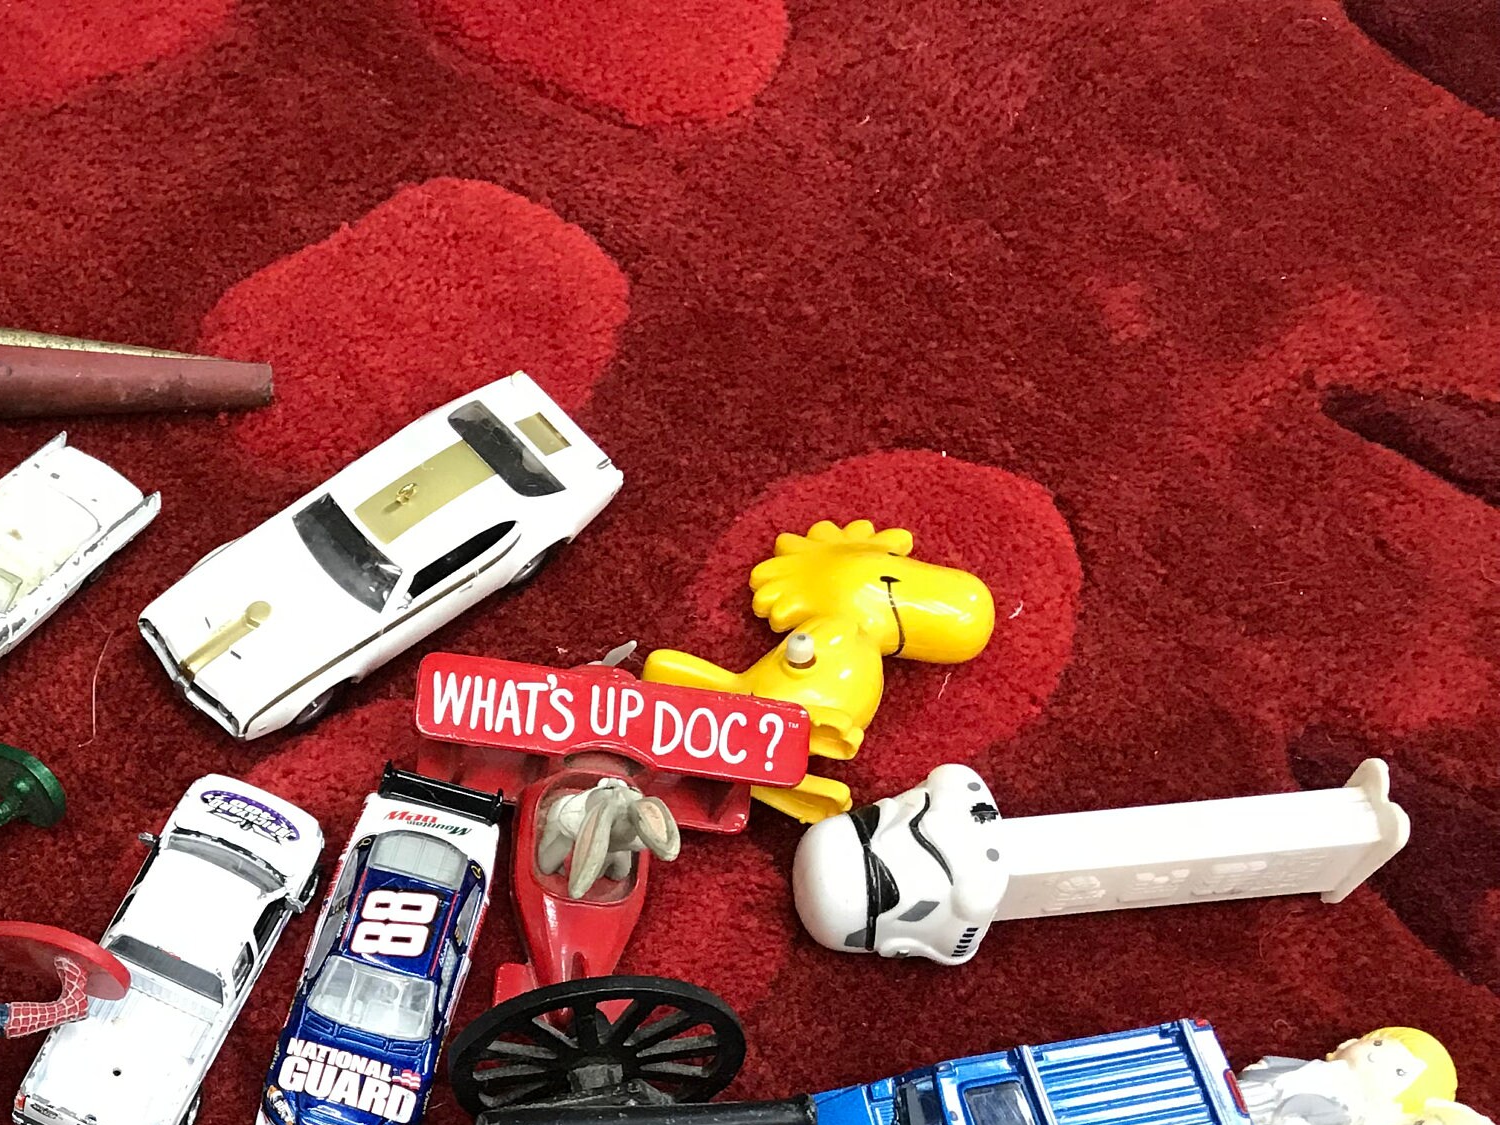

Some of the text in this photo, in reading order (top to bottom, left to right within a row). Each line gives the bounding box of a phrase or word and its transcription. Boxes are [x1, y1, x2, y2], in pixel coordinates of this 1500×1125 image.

[433, 671, 575, 742] WHAT'S
[589, 684, 644, 738] UP
[652, 701, 747, 765] DOC
[758, 713, 784, 772] ?
[406, 820, 473, 836] Mountain
[351, 889, 440, 958] 88
[278, 1055, 417, 1124] GUARD
[286, 1037, 393, 1082] NATIONAL
